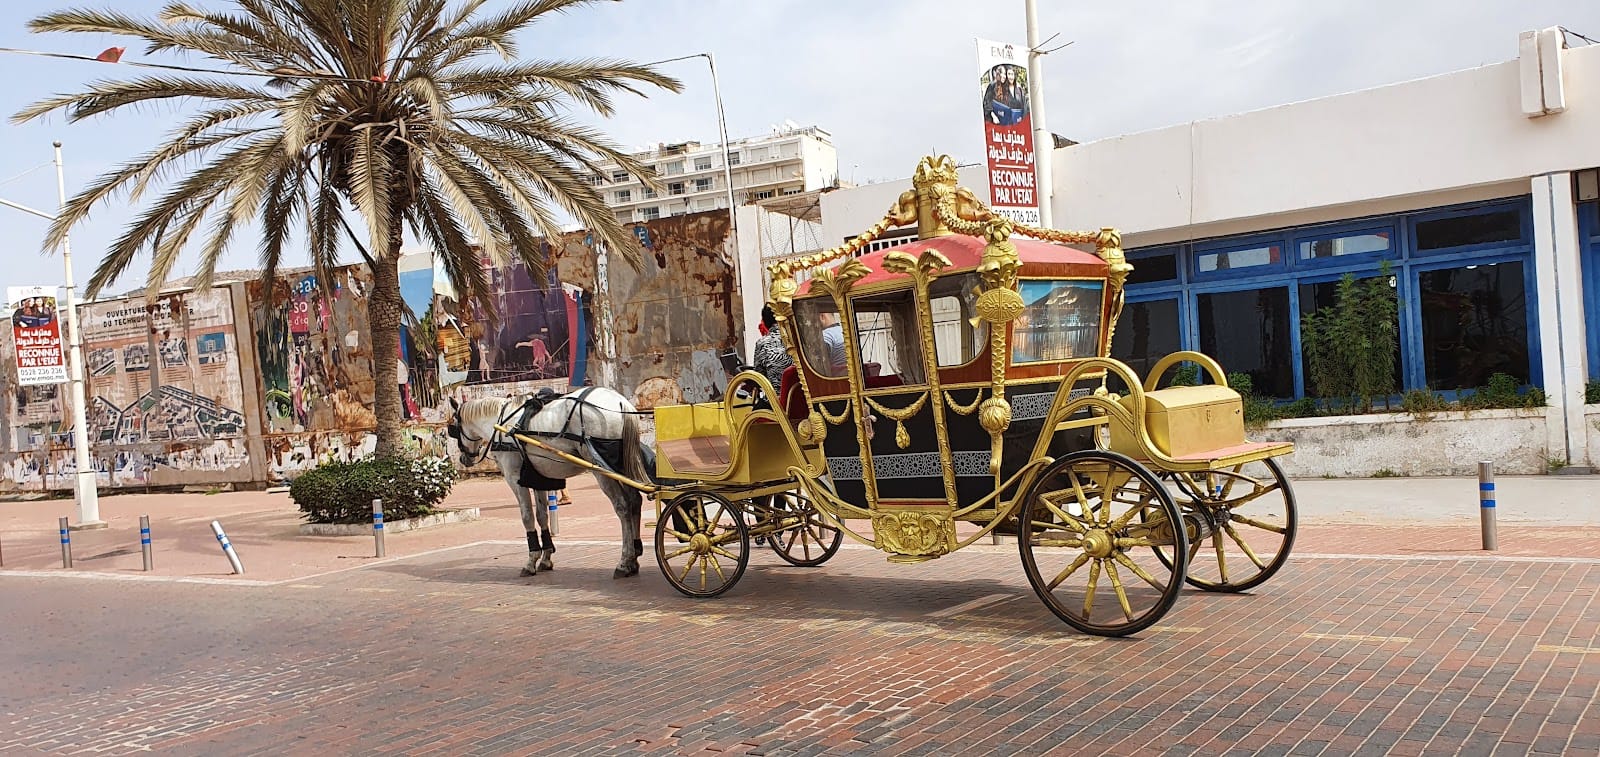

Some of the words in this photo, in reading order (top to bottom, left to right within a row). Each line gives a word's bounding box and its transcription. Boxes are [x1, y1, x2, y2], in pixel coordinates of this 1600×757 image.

[991, 169, 1034, 188] RECONNUE
[995, 187, 1010, 203] PAR
[1011, 188, 1033, 204] L'ETAT
[1025, 210, 1038, 223] 236
[106, 306, 146, 319] OUVERTURE
[103, 320, 112, 328] DU
[18, 348, 60, 358] RECONNUE
[22, 358, 36, 367] PAR
